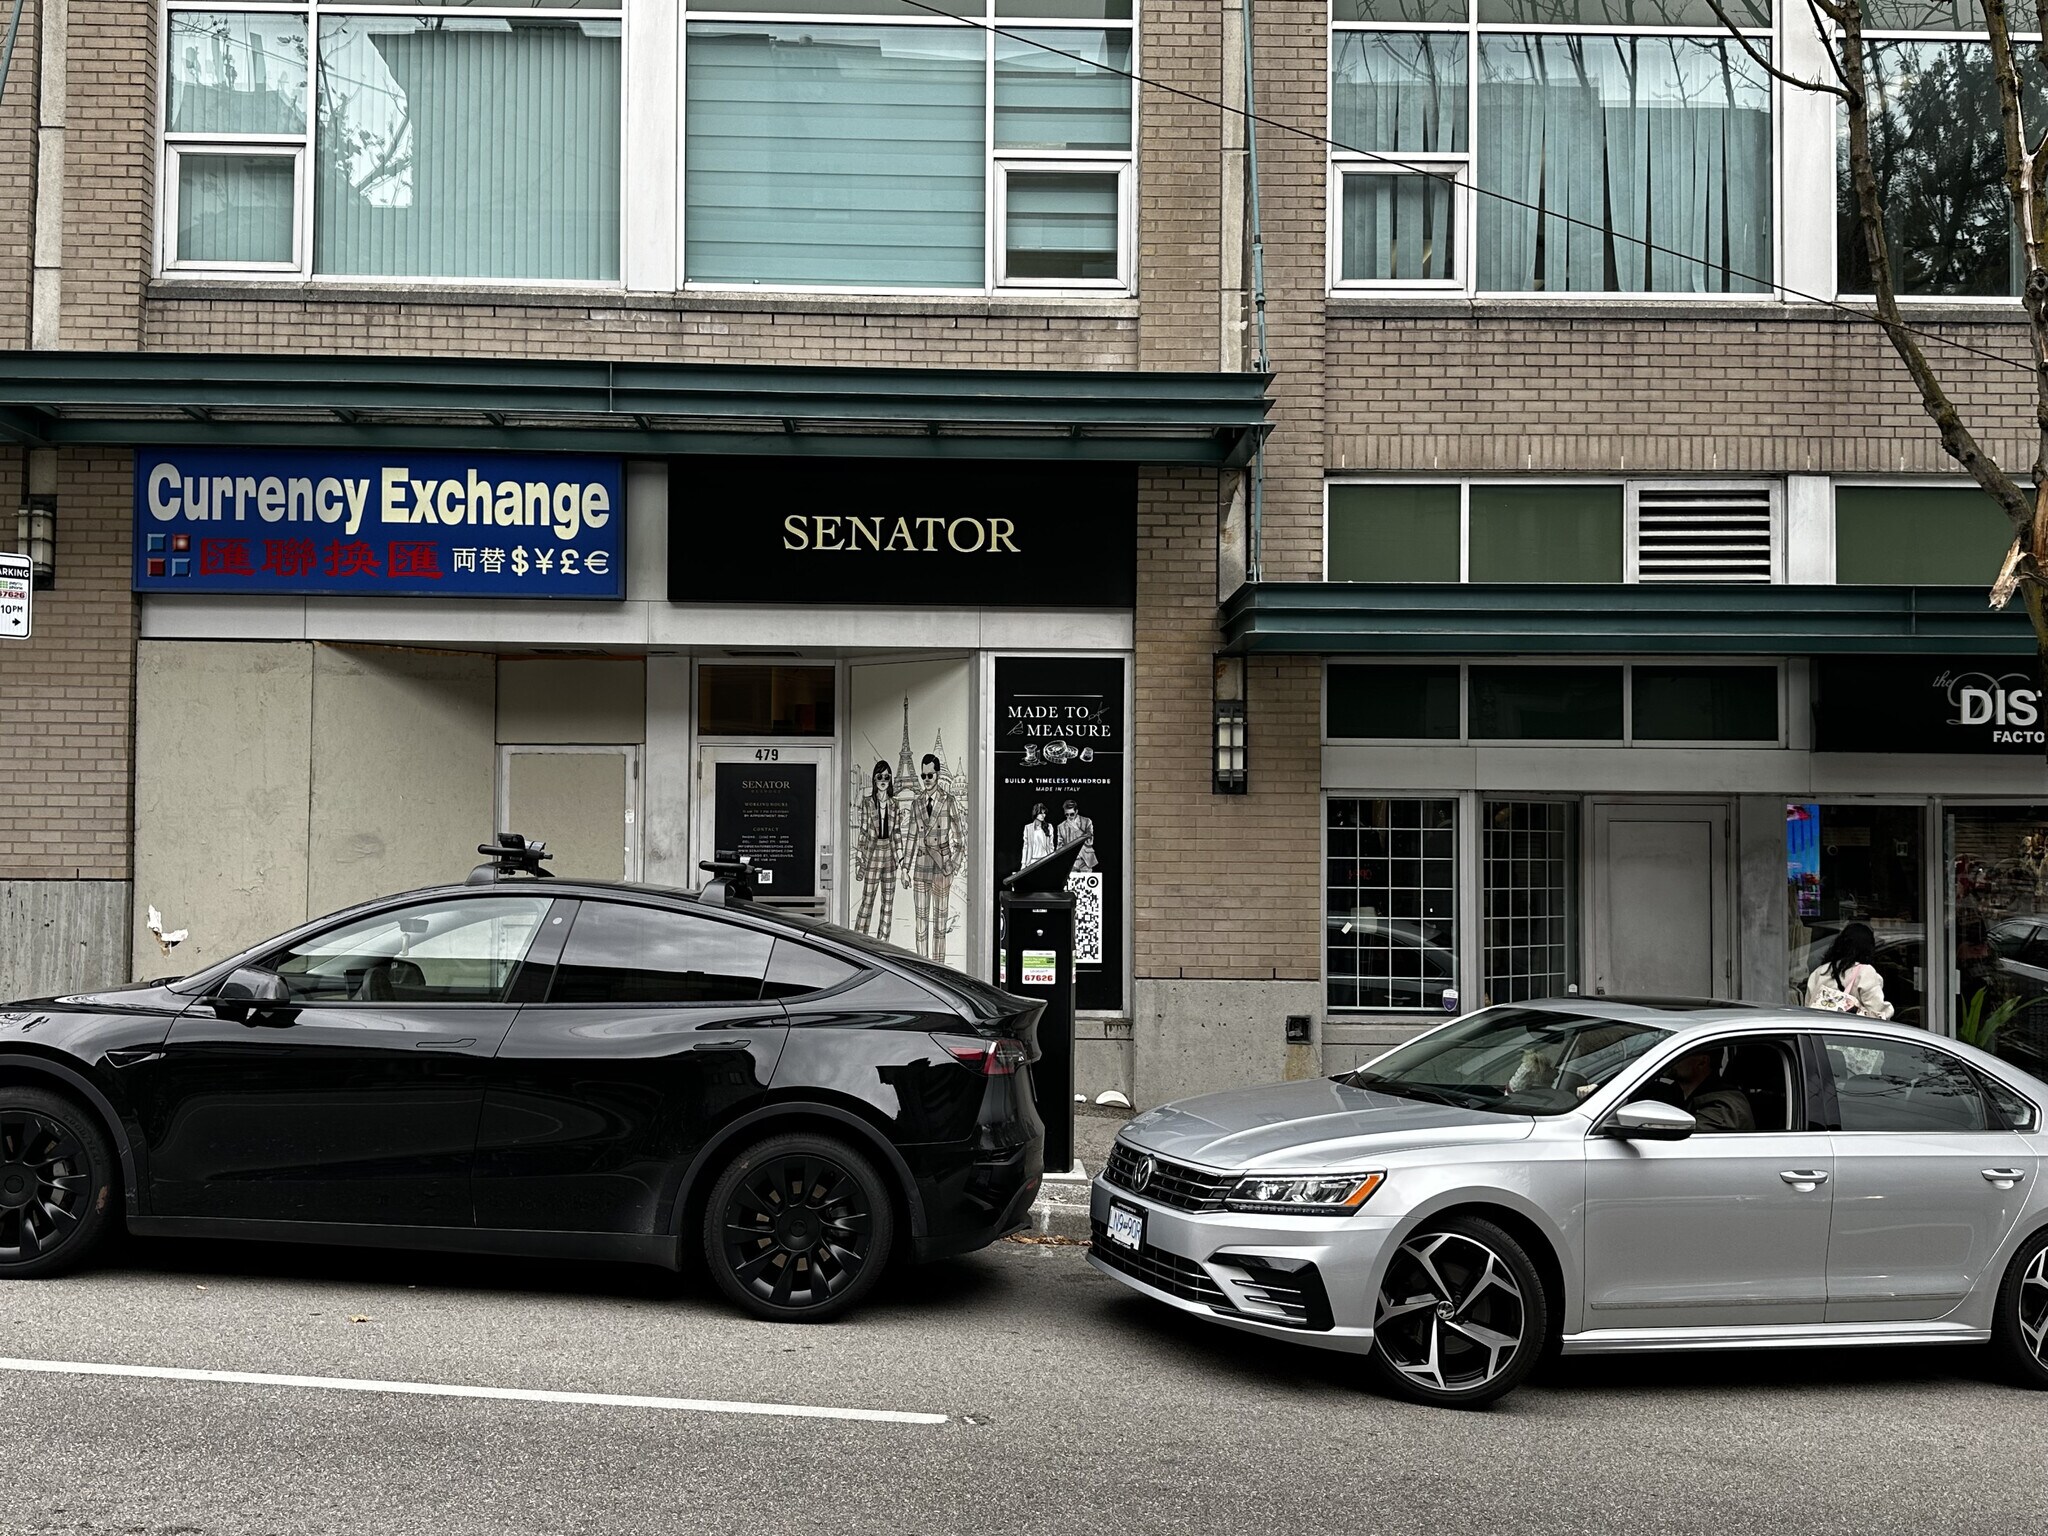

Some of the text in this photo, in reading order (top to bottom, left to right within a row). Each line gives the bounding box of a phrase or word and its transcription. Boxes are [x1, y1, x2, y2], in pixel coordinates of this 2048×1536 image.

[148, 462, 610, 540] Currency Exchange
[783, 514, 1021, 553] SENATOR
[1008, 706, 1089, 718] MADE TO
[1960, 689, 2043, 726] DIS
[1027, 724, 1111, 737] MEASURE
[755, 749, 779, 761] 479
[742, 780, 791, 789] SENATOR
[1071, 777, 1111, 785] WARDROBE
